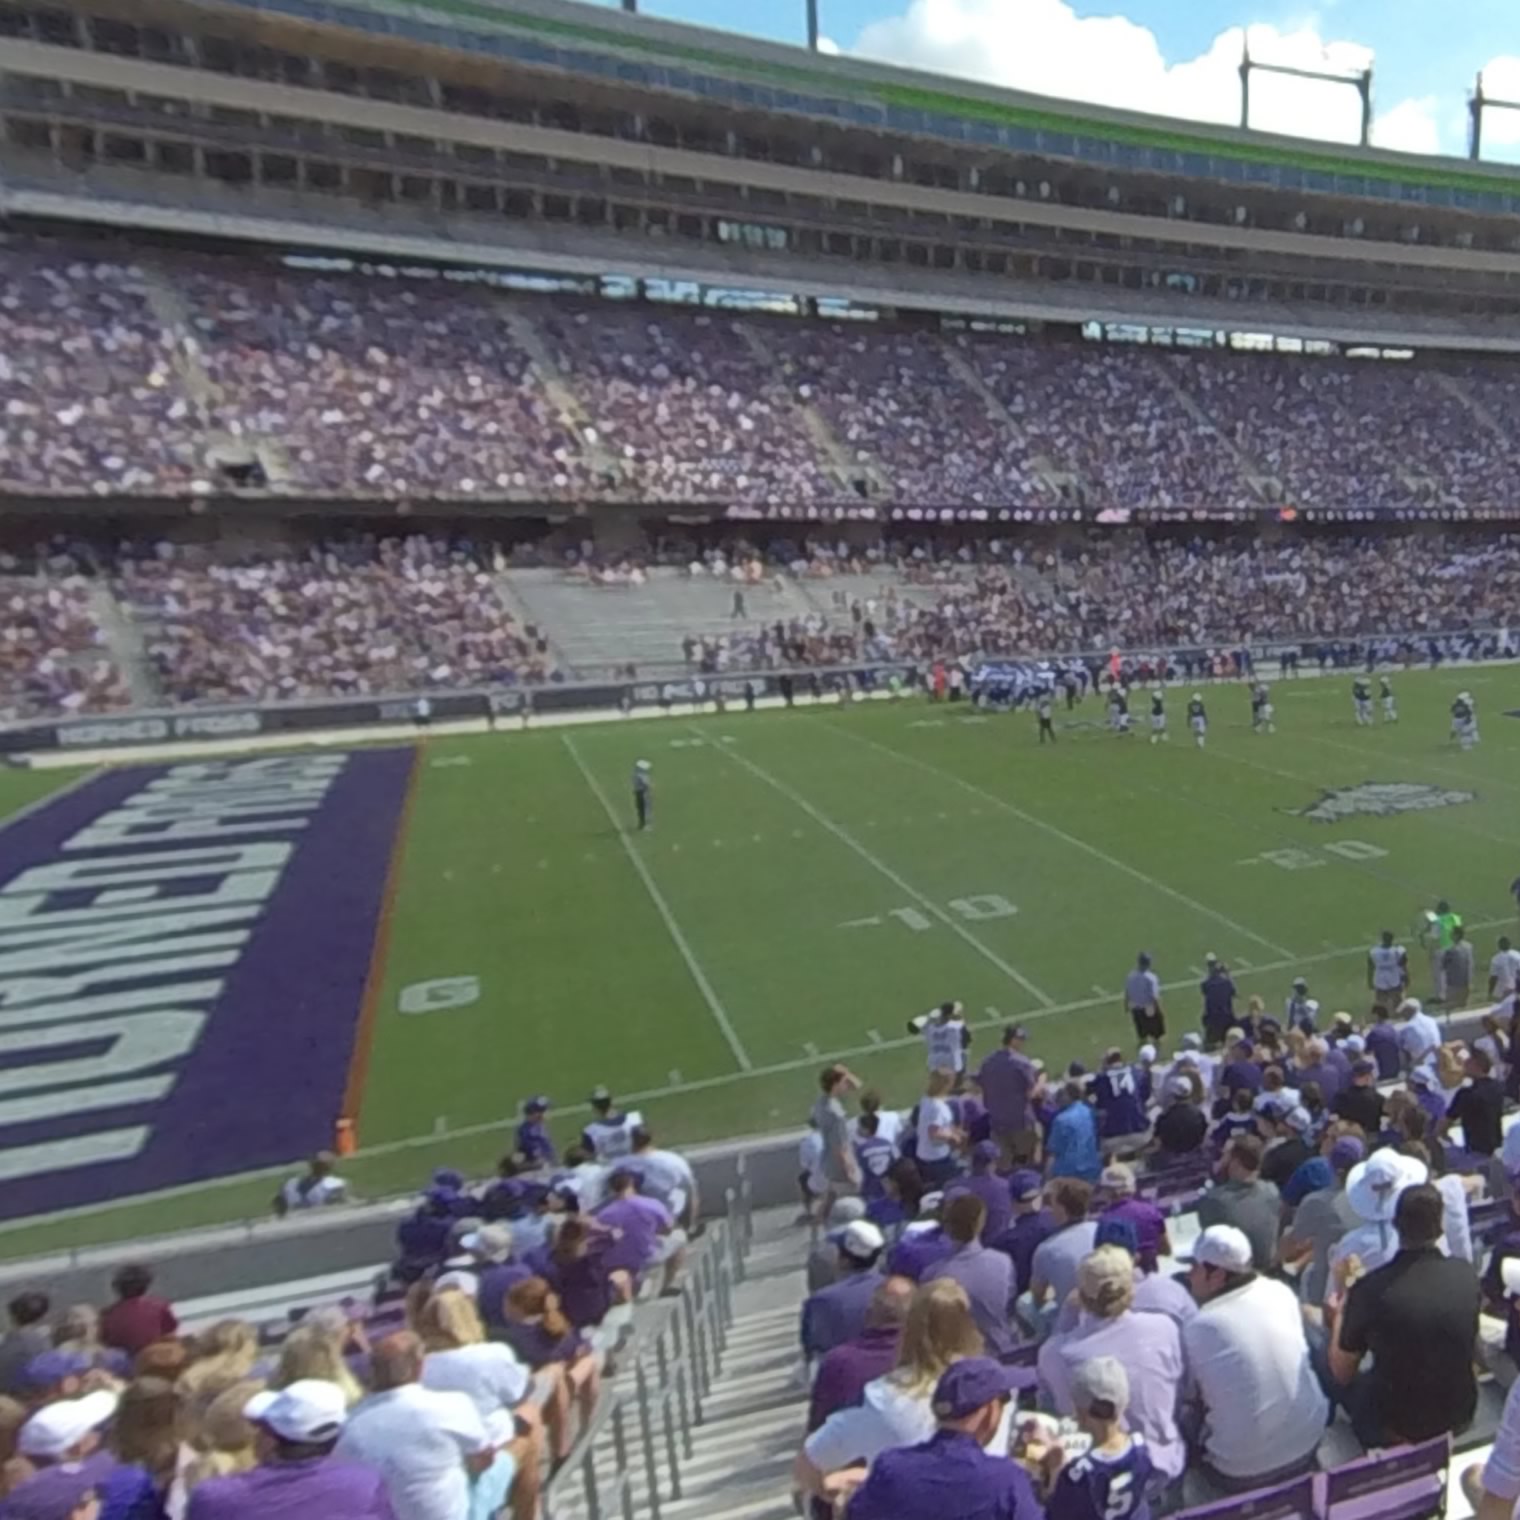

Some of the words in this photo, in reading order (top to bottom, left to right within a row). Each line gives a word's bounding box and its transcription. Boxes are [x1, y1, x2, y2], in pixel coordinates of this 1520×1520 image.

[1258, 840, 1390, 870] 20
[887, 893, 1019, 931] 10
[1106, 1065, 1135, 1098] 14
[1104, 1470, 1134, 1520] 5
